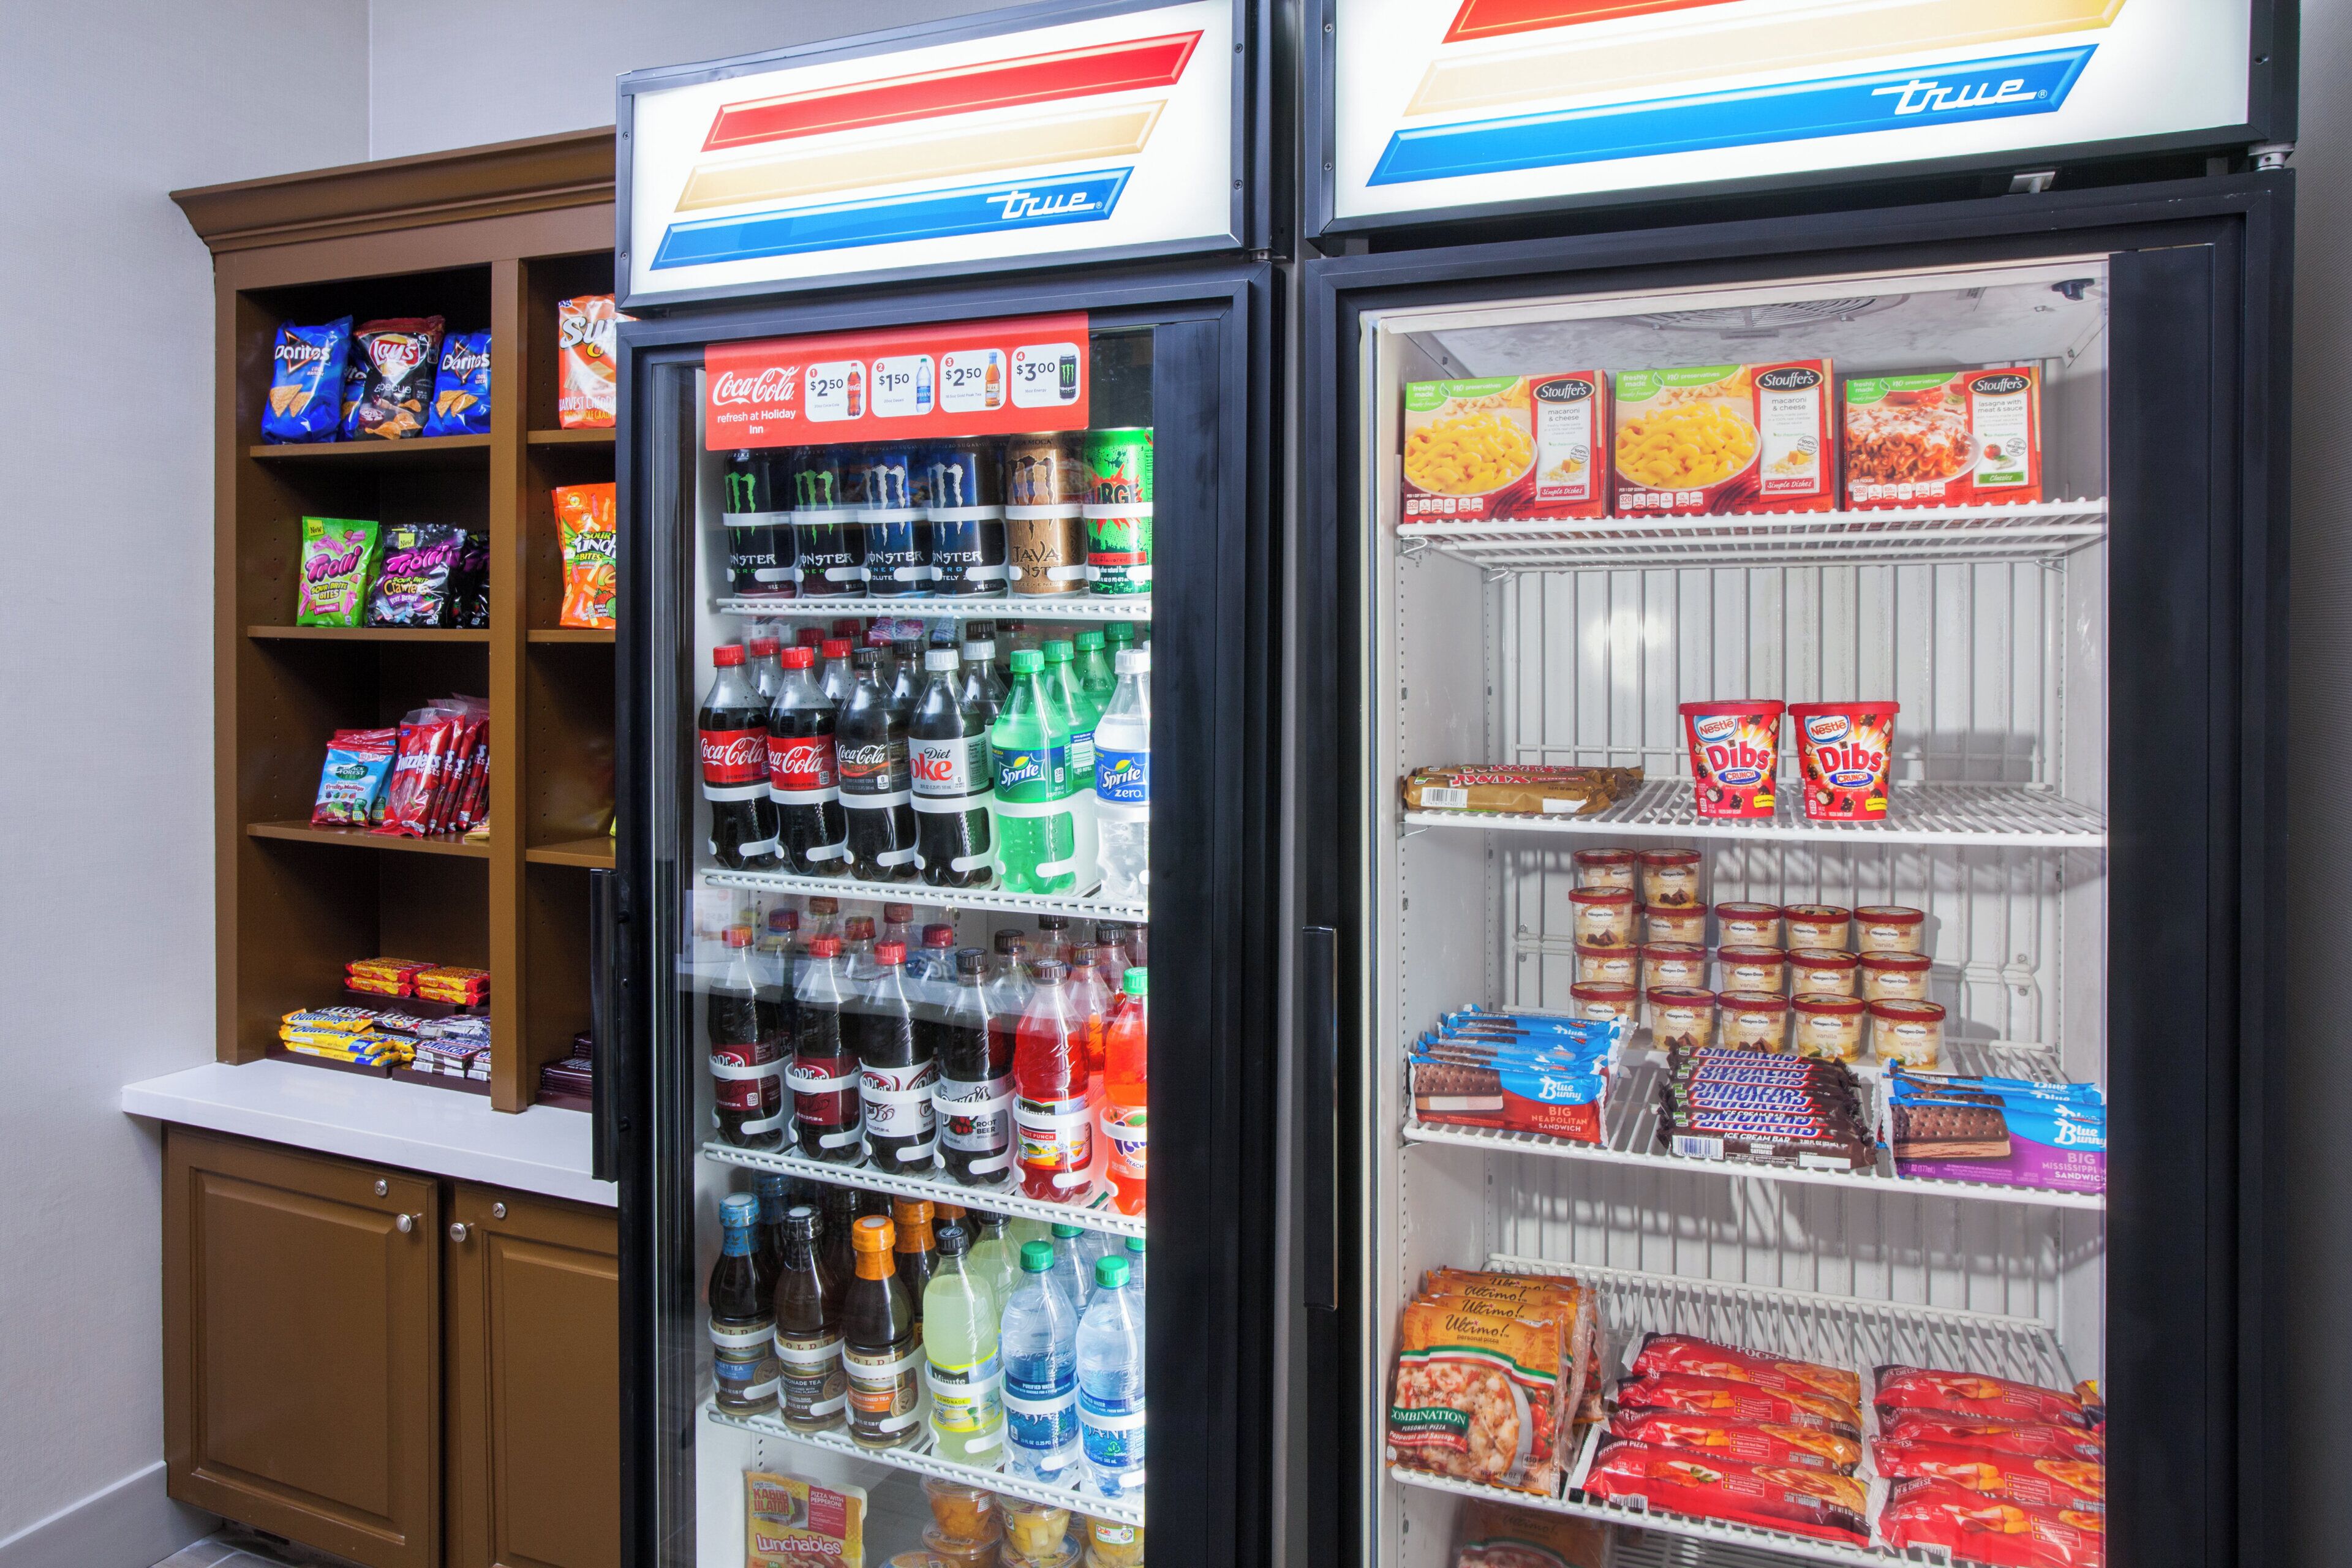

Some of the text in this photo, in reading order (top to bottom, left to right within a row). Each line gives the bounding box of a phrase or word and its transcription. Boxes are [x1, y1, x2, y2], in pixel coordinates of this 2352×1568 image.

[275, 344, 331, 361] Doritos
[442, 353, 490, 370] Doritos
[1623, 374, 1648, 382] freshly
[1680, 371, 1721, 380] preservatives
[1763, 370, 1814, 388] Stouffer's
[713, 366, 801, 406] Coca-Cola
[1905, 378, 1941, 386] preservatives
[1976, 376, 2023, 393] Stouffer's
[1540, 382, 1587, 399] Stouffer's
[717, 409, 796, 423] refresh at Holiday
[749, 424, 764, 434] Inn
[1766, 480, 1812, 491] Simple Dishes
[1012, 541, 1061, 564] JAVA
[306, 546, 363, 582] Trolli
[387, 545, 449, 573] Trolli
[311, 584, 328, 594] SOUR
[319, 590, 339, 600] BITES
[701, 734, 766, 766] Coca-Cola
[839, 742, 888, 765] Coca-Cola
[924, 747, 951, 760] Diet
[1705, 741, 1771, 772] Dibs
[1816, 741, 1884, 774] Dibs
[910, 753, 953, 782] oke
[1000, 761, 1039, 786] Sprite
[1102, 764, 1141, 790] Sprite
[1725, 772, 1755, 781] CRUNCH
[1837, 774, 1867, 783] CRUNCH
[1114, 789, 1141, 798] zero
[1549, 1106, 1572, 1117] BIG
[977, 1118, 997, 1128] ROOT
[1531, 1115, 1588, 1125] NEAPOLITAN
[1020, 1128, 1032, 1137] FRUIT
[1538, 1123, 1581, 1133] SANDWICH
[1739, 1133, 1771, 1142] CREAM
[1771, 1134, 1790, 1144] BAR
[1126, 1158, 1144, 1169] PEACH
[2067, 1152, 2096, 1164] BIG
[2042, 1162, 2097, 1174] MISSISSIPPI
[1464, 1284, 1526, 1303] Ultimo!
[1461, 1298, 1524, 1318] Ultimo!
[1446, 1313, 1509, 1338] Ultimo!
[1457, 1334, 1483, 1343] personal
[1390, 1431, 1416, 1440] Pepperoni
[1429, 1433, 1455, 1442] Sausage
[1629, 1440, 1648, 1450] PIZZA
[1523, 1455, 1537, 1464] 450
[1908, 1477, 1932, 1491] CHEESE
[810, 1490, 844, 1502] PIZZA WITH
[810, 1496, 842, 1508] PEPPERONI
[1097, 1525, 1111, 1536] Dole
[756, 1532, 843, 1556] Lunchables
